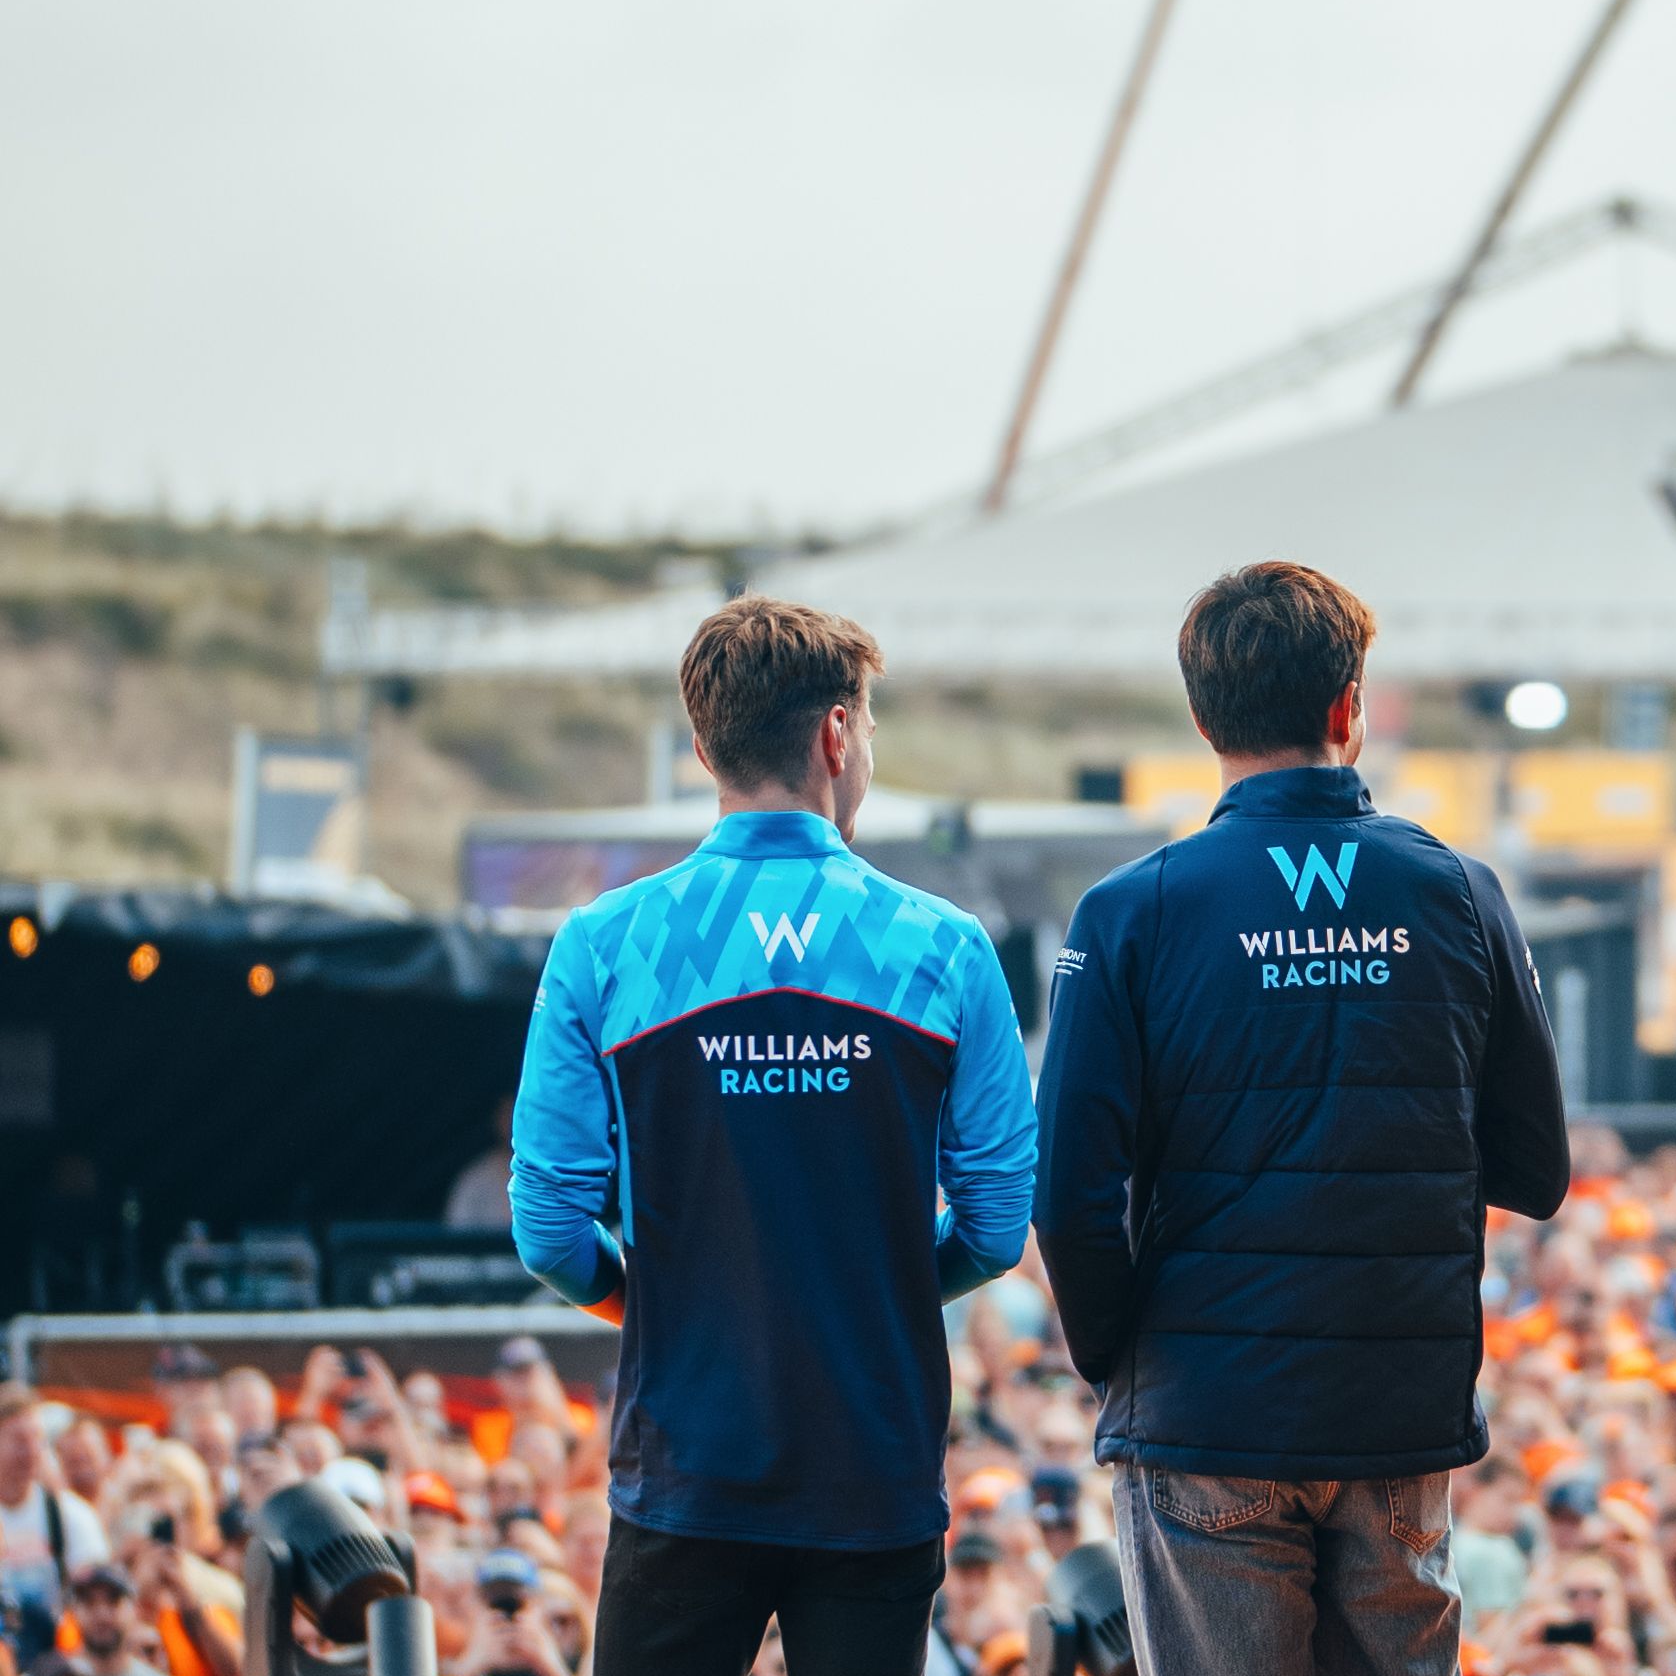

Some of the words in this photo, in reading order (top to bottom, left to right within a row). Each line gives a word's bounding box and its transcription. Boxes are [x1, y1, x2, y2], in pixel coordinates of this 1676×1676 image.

[1238, 927, 1411, 959] WILLIAMS
[1261, 959, 1391, 989] RACING
[698, 1034, 872, 1062] WILLIAMS
[720, 1066, 851, 1094] RACING
